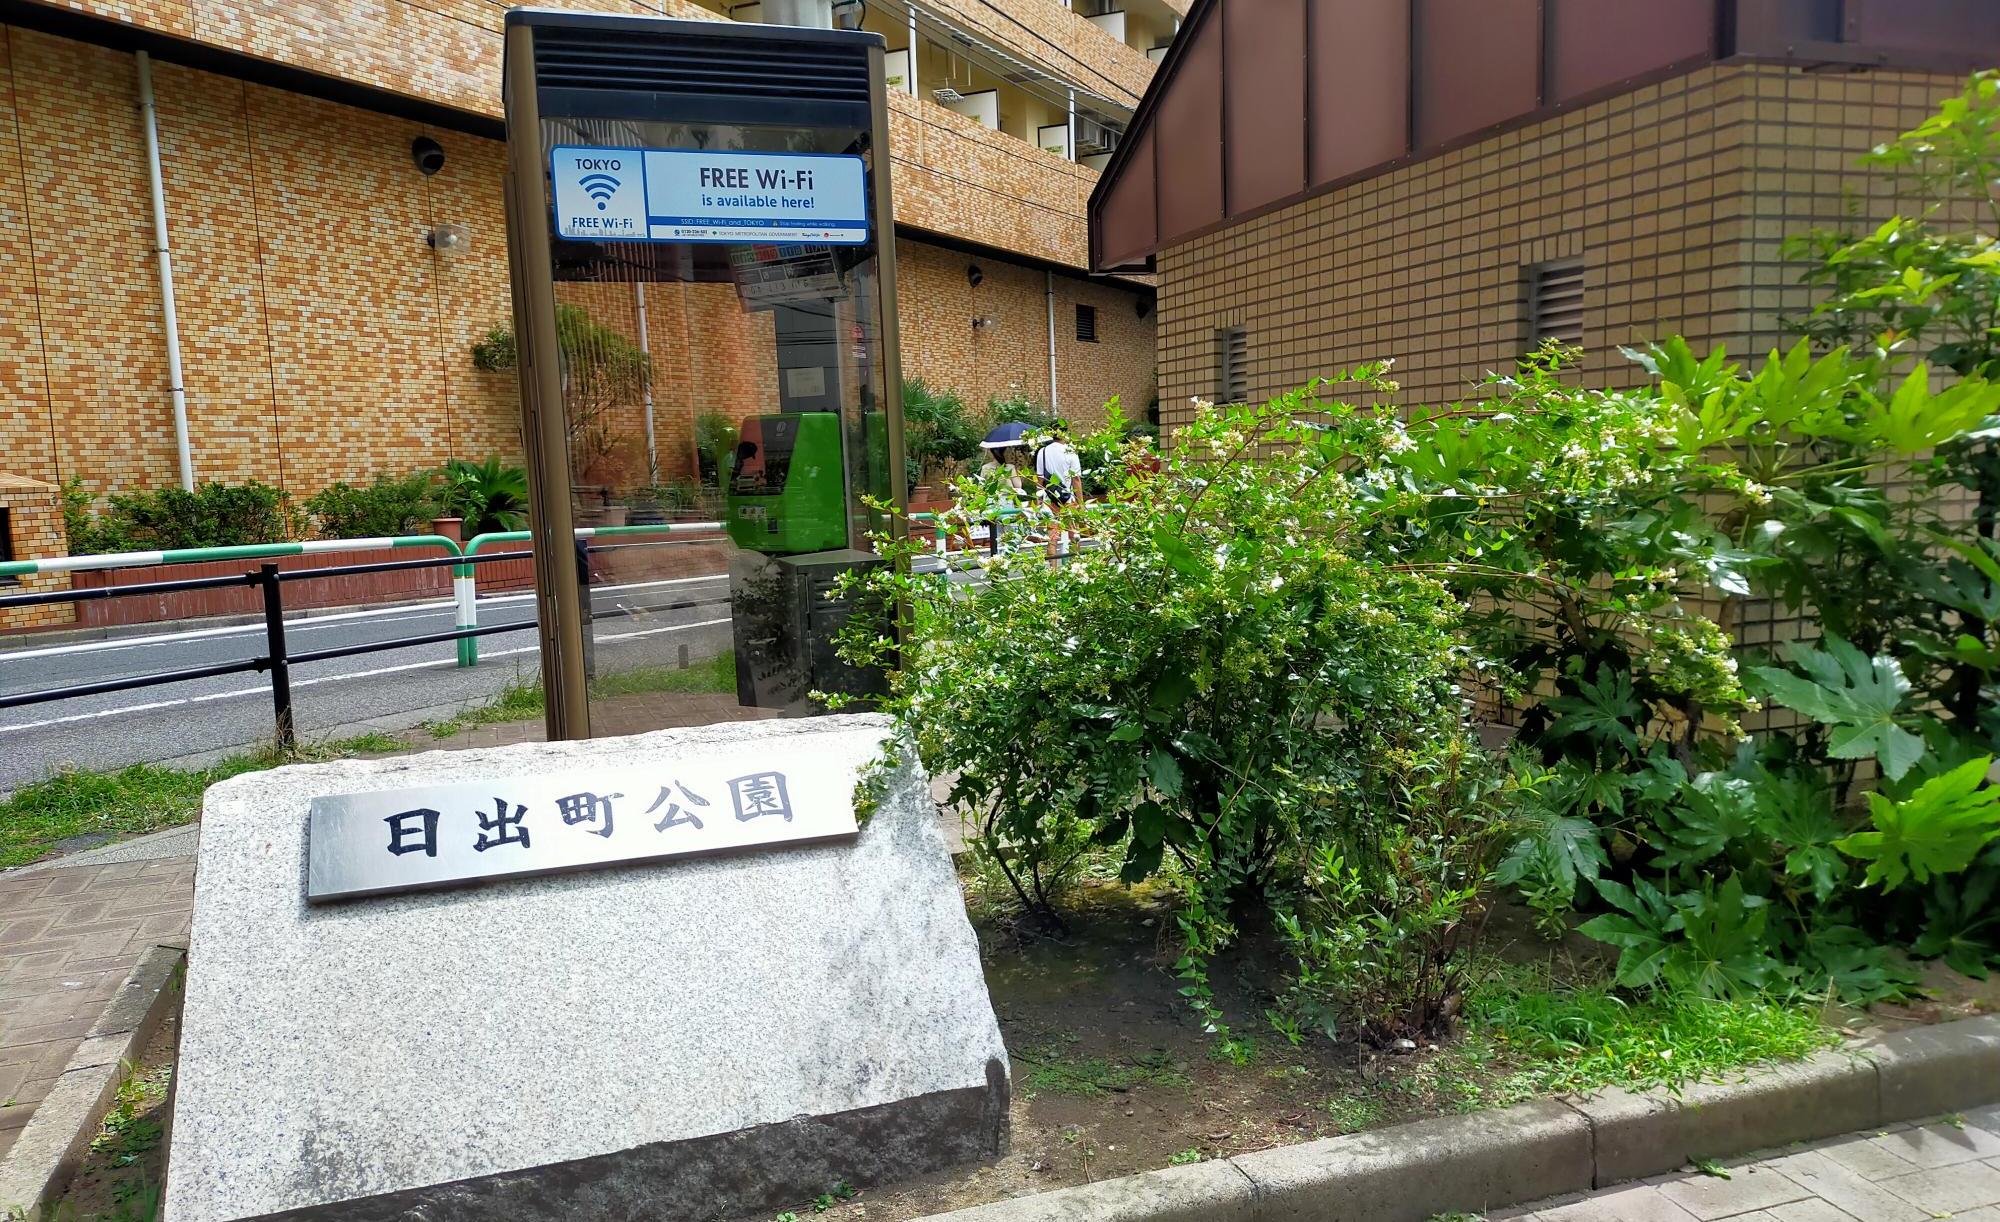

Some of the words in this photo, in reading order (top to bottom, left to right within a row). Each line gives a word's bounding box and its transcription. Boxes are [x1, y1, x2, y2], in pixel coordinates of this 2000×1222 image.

[575, 158, 621, 171] TOKYO
[700, 167, 749, 189] FREE
[755, 168, 814, 190] Wi-Fi
[702, 194, 713, 206] is
[717, 194, 778, 208] available
[782, 196, 815, 208] here!
[572, 217, 599, 228] FREE
[602, 217, 633, 229] Wi-Fi
[382, 771, 793, 858] 日出町公園
